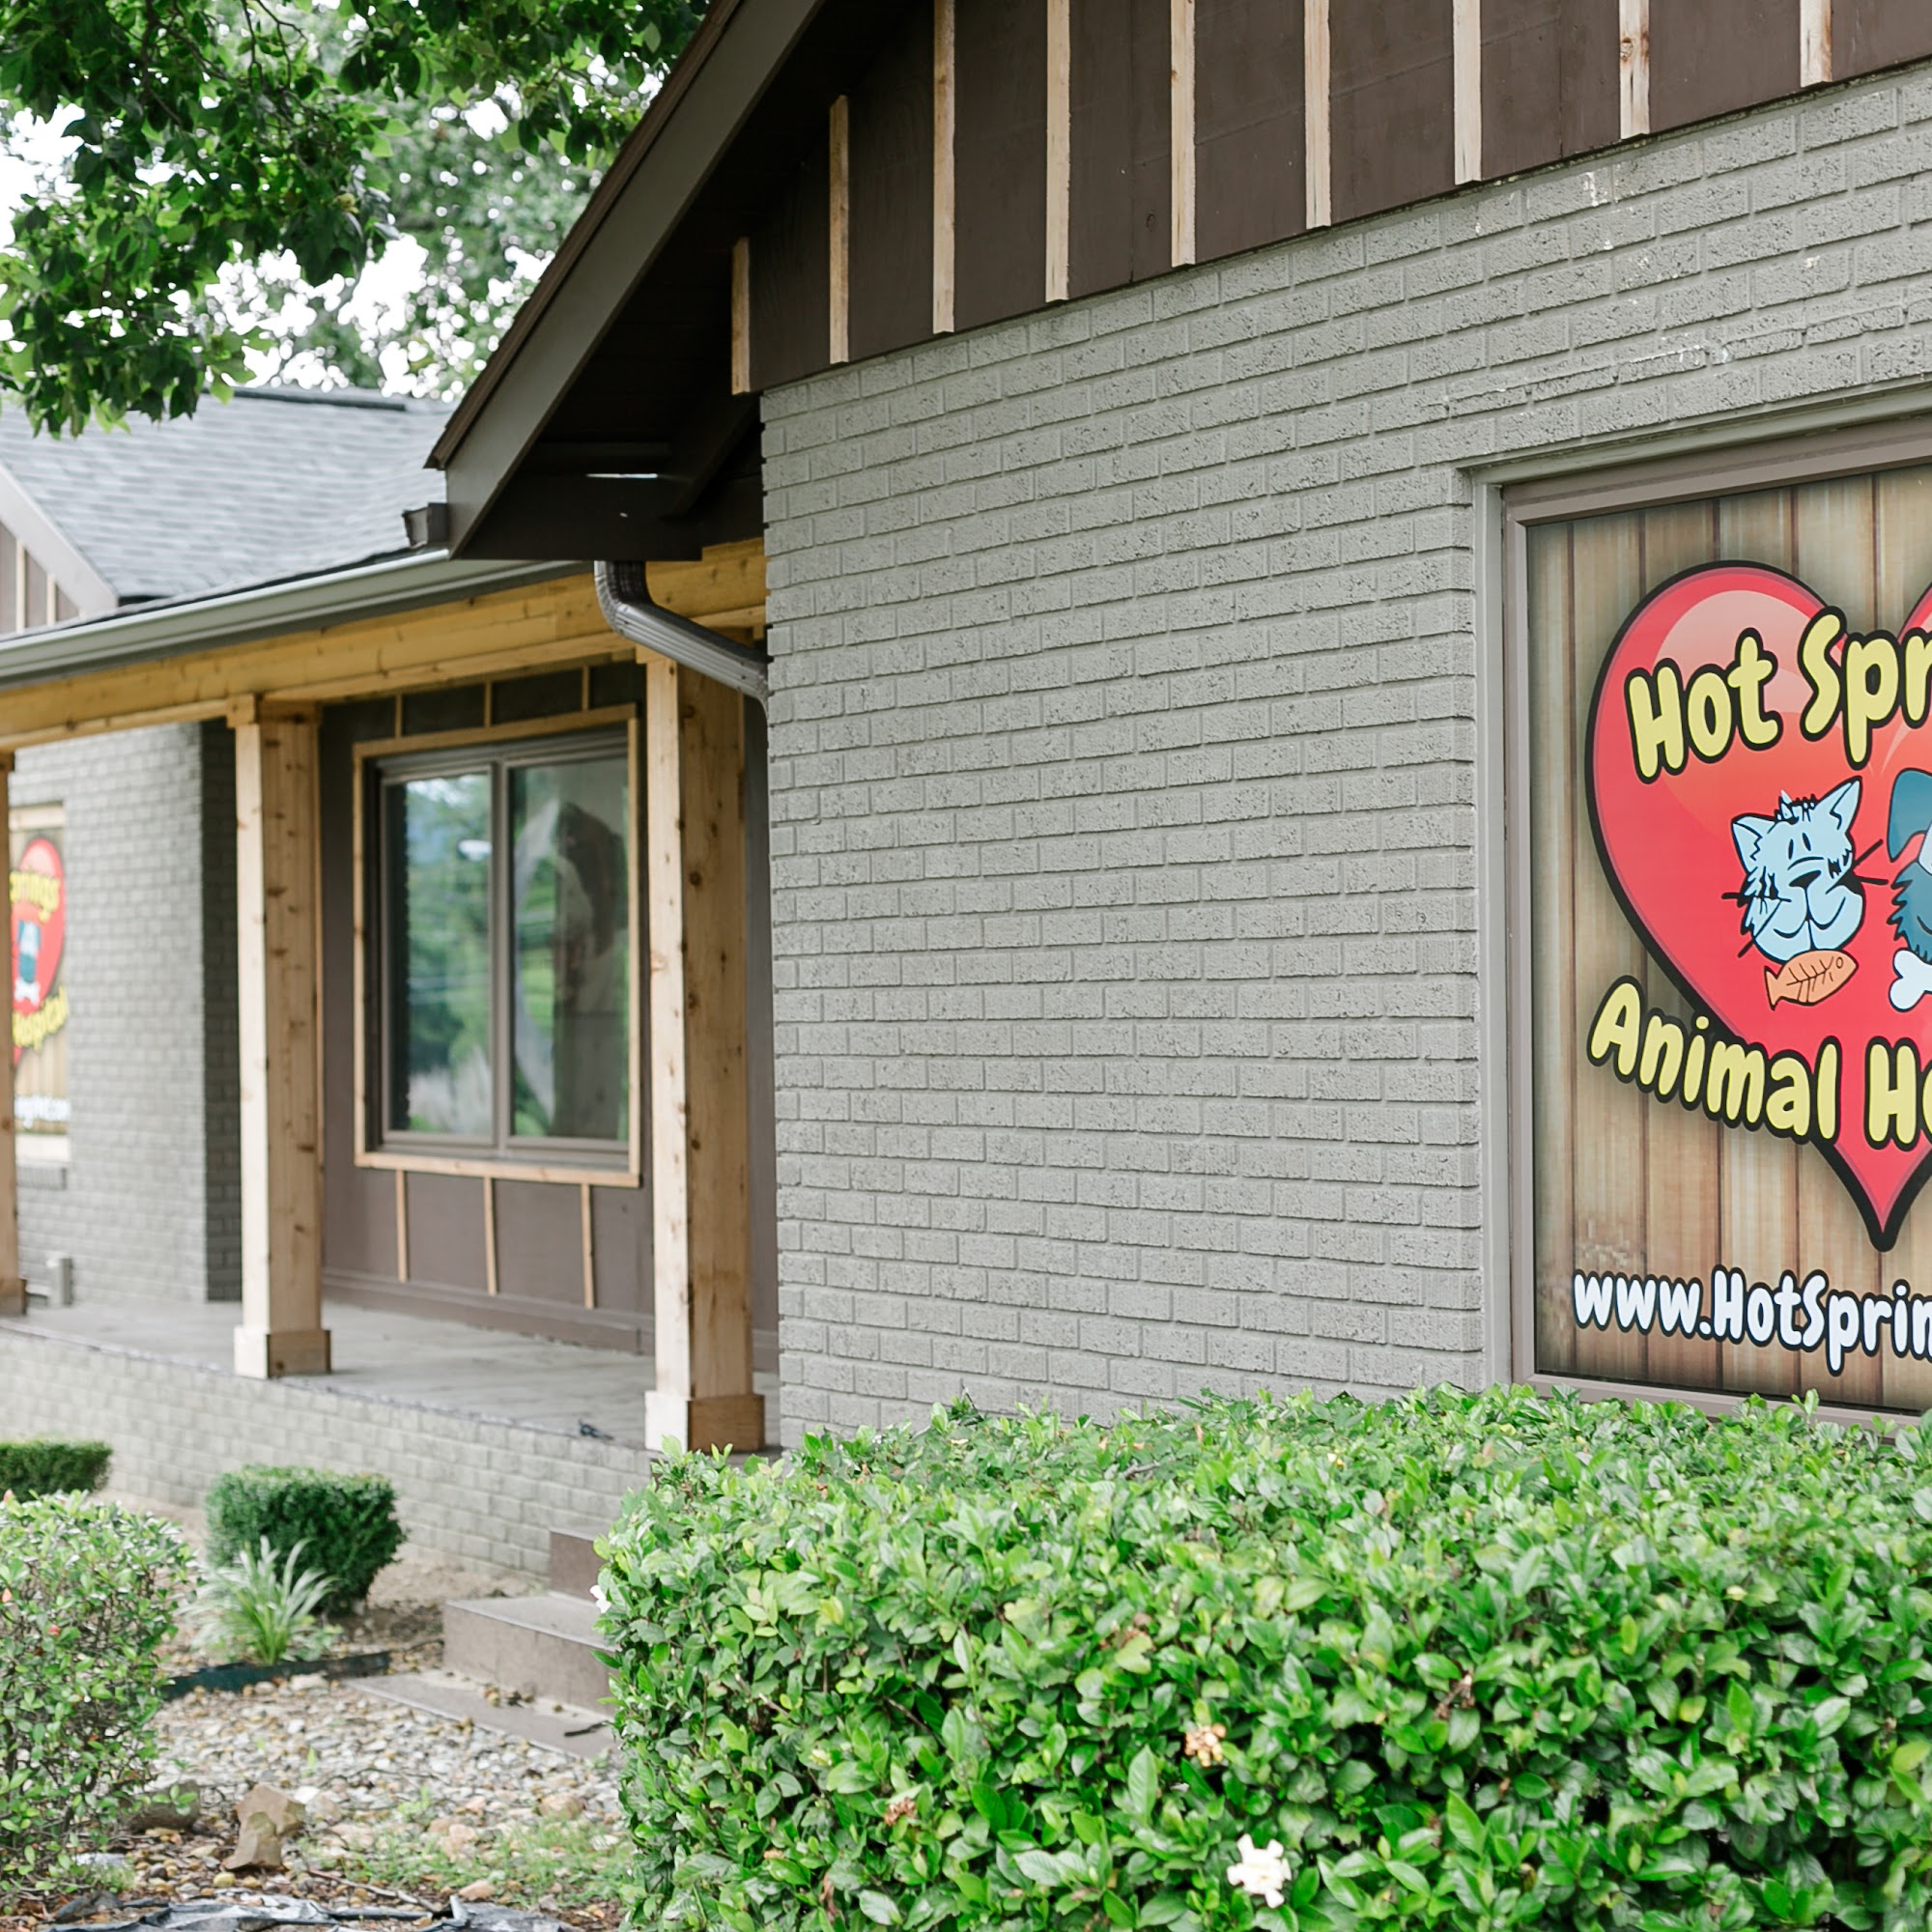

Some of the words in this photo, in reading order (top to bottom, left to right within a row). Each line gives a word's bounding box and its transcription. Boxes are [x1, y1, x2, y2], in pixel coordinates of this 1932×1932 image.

[1626, 632, 1780, 781] Hot
[1588, 980, 1839, 1142] Animal
[1865, 1039, 1932, 1148] H
